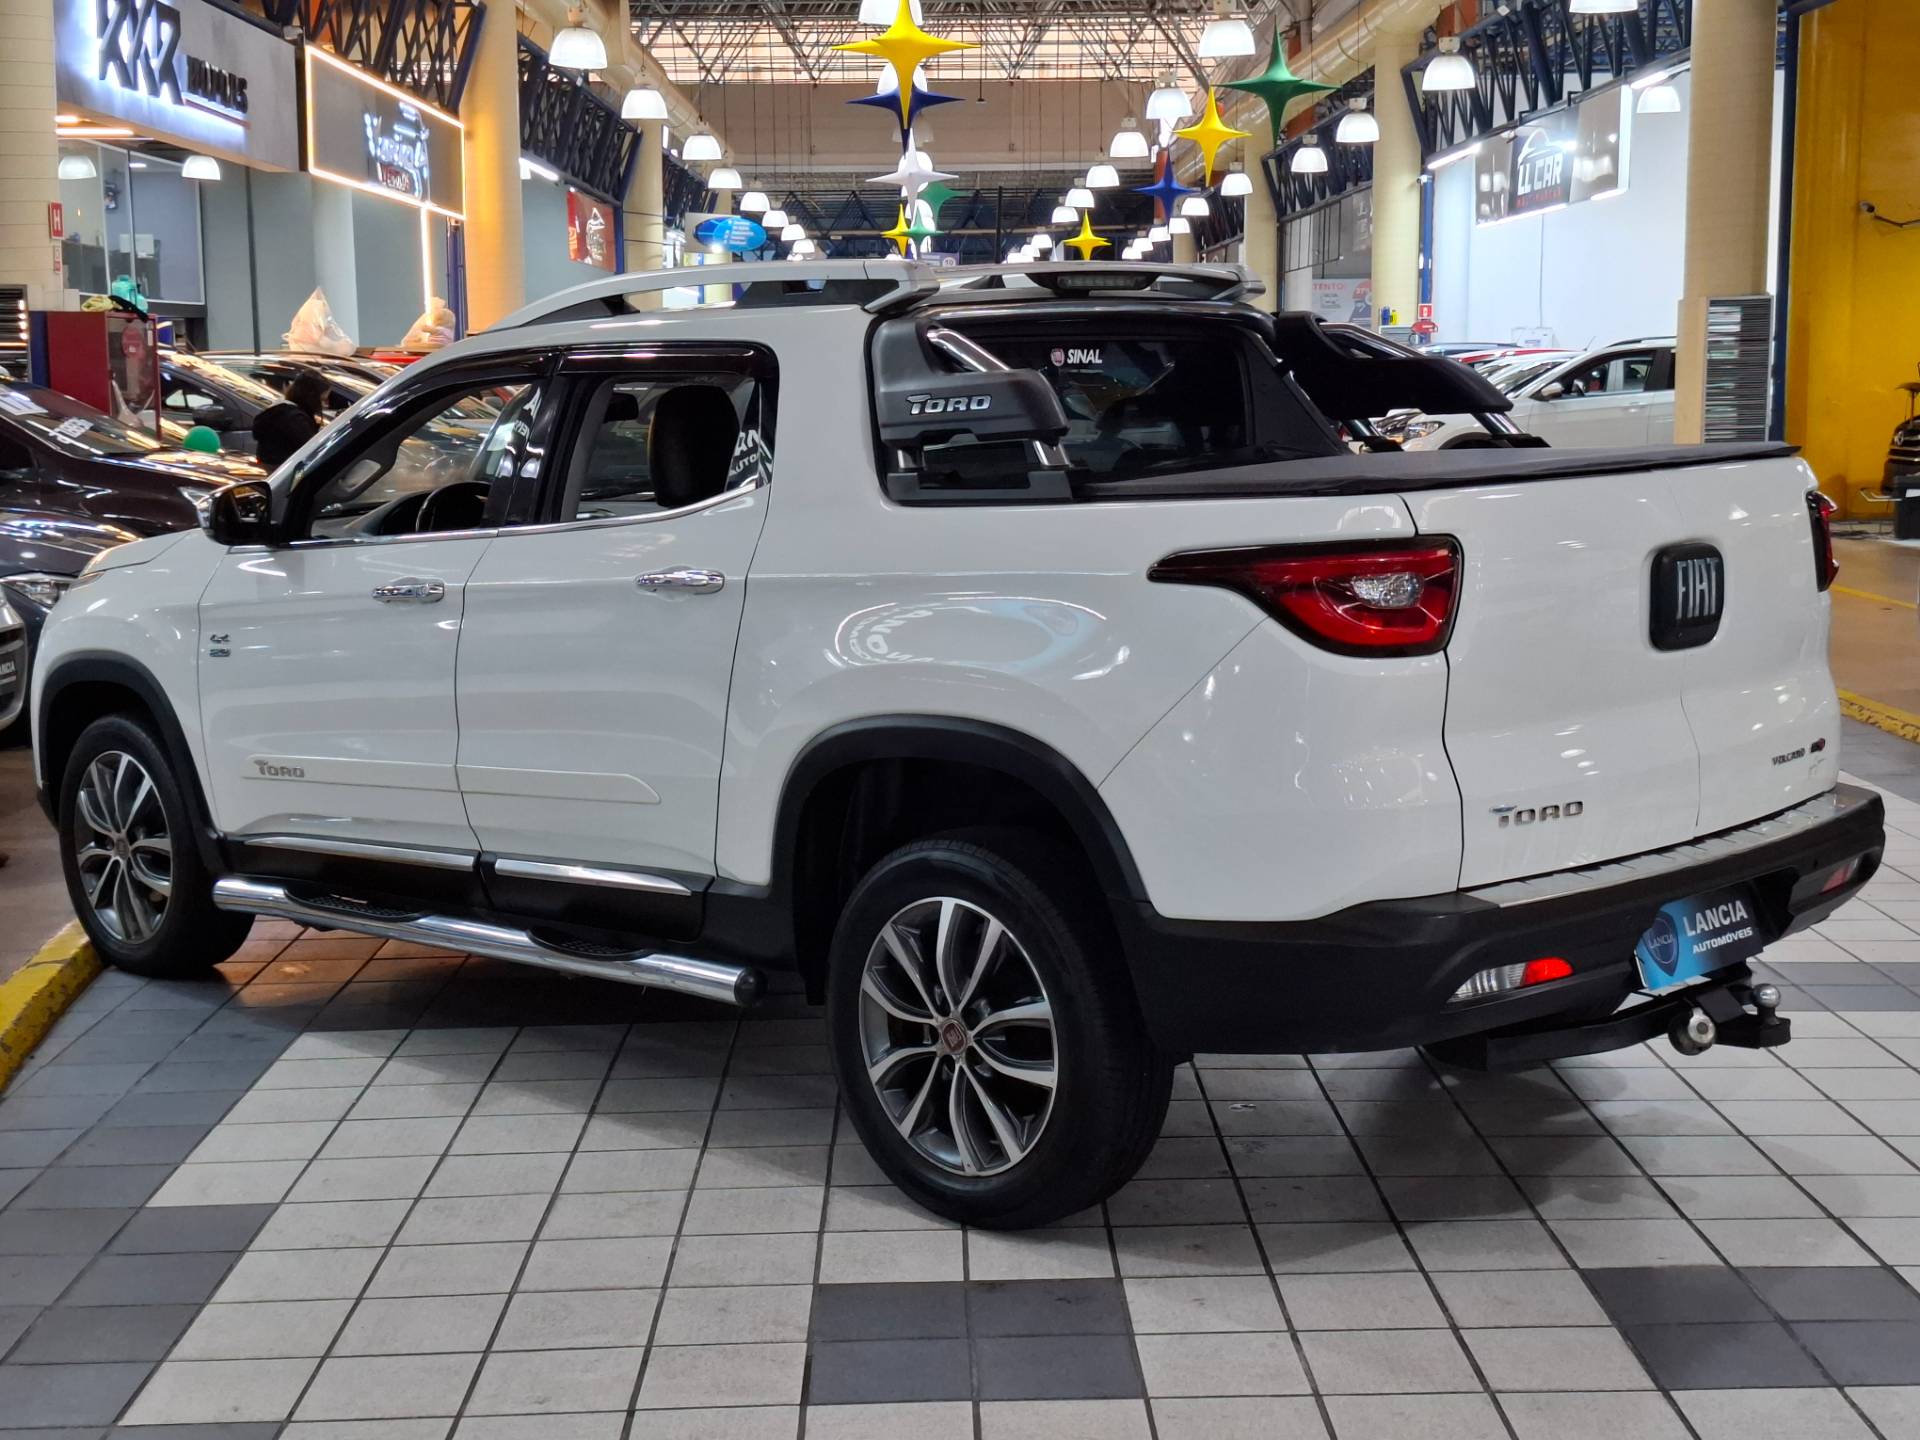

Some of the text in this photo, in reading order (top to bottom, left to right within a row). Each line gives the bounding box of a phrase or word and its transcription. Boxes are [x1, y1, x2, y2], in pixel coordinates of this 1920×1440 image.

[1533, 152, 1563, 191] CAR
[1066, 349, 1103, 364] SINAL
[907, 394, 992, 415] TORO
[1676, 558, 1719, 620] FIAT
[253, 759, 305, 778] TORO
[1489, 800, 1584, 829] TORO
[1682, 900, 1749, 937] LANCIA
[1692, 926, 1753, 954] AUTOMÓVEIS
